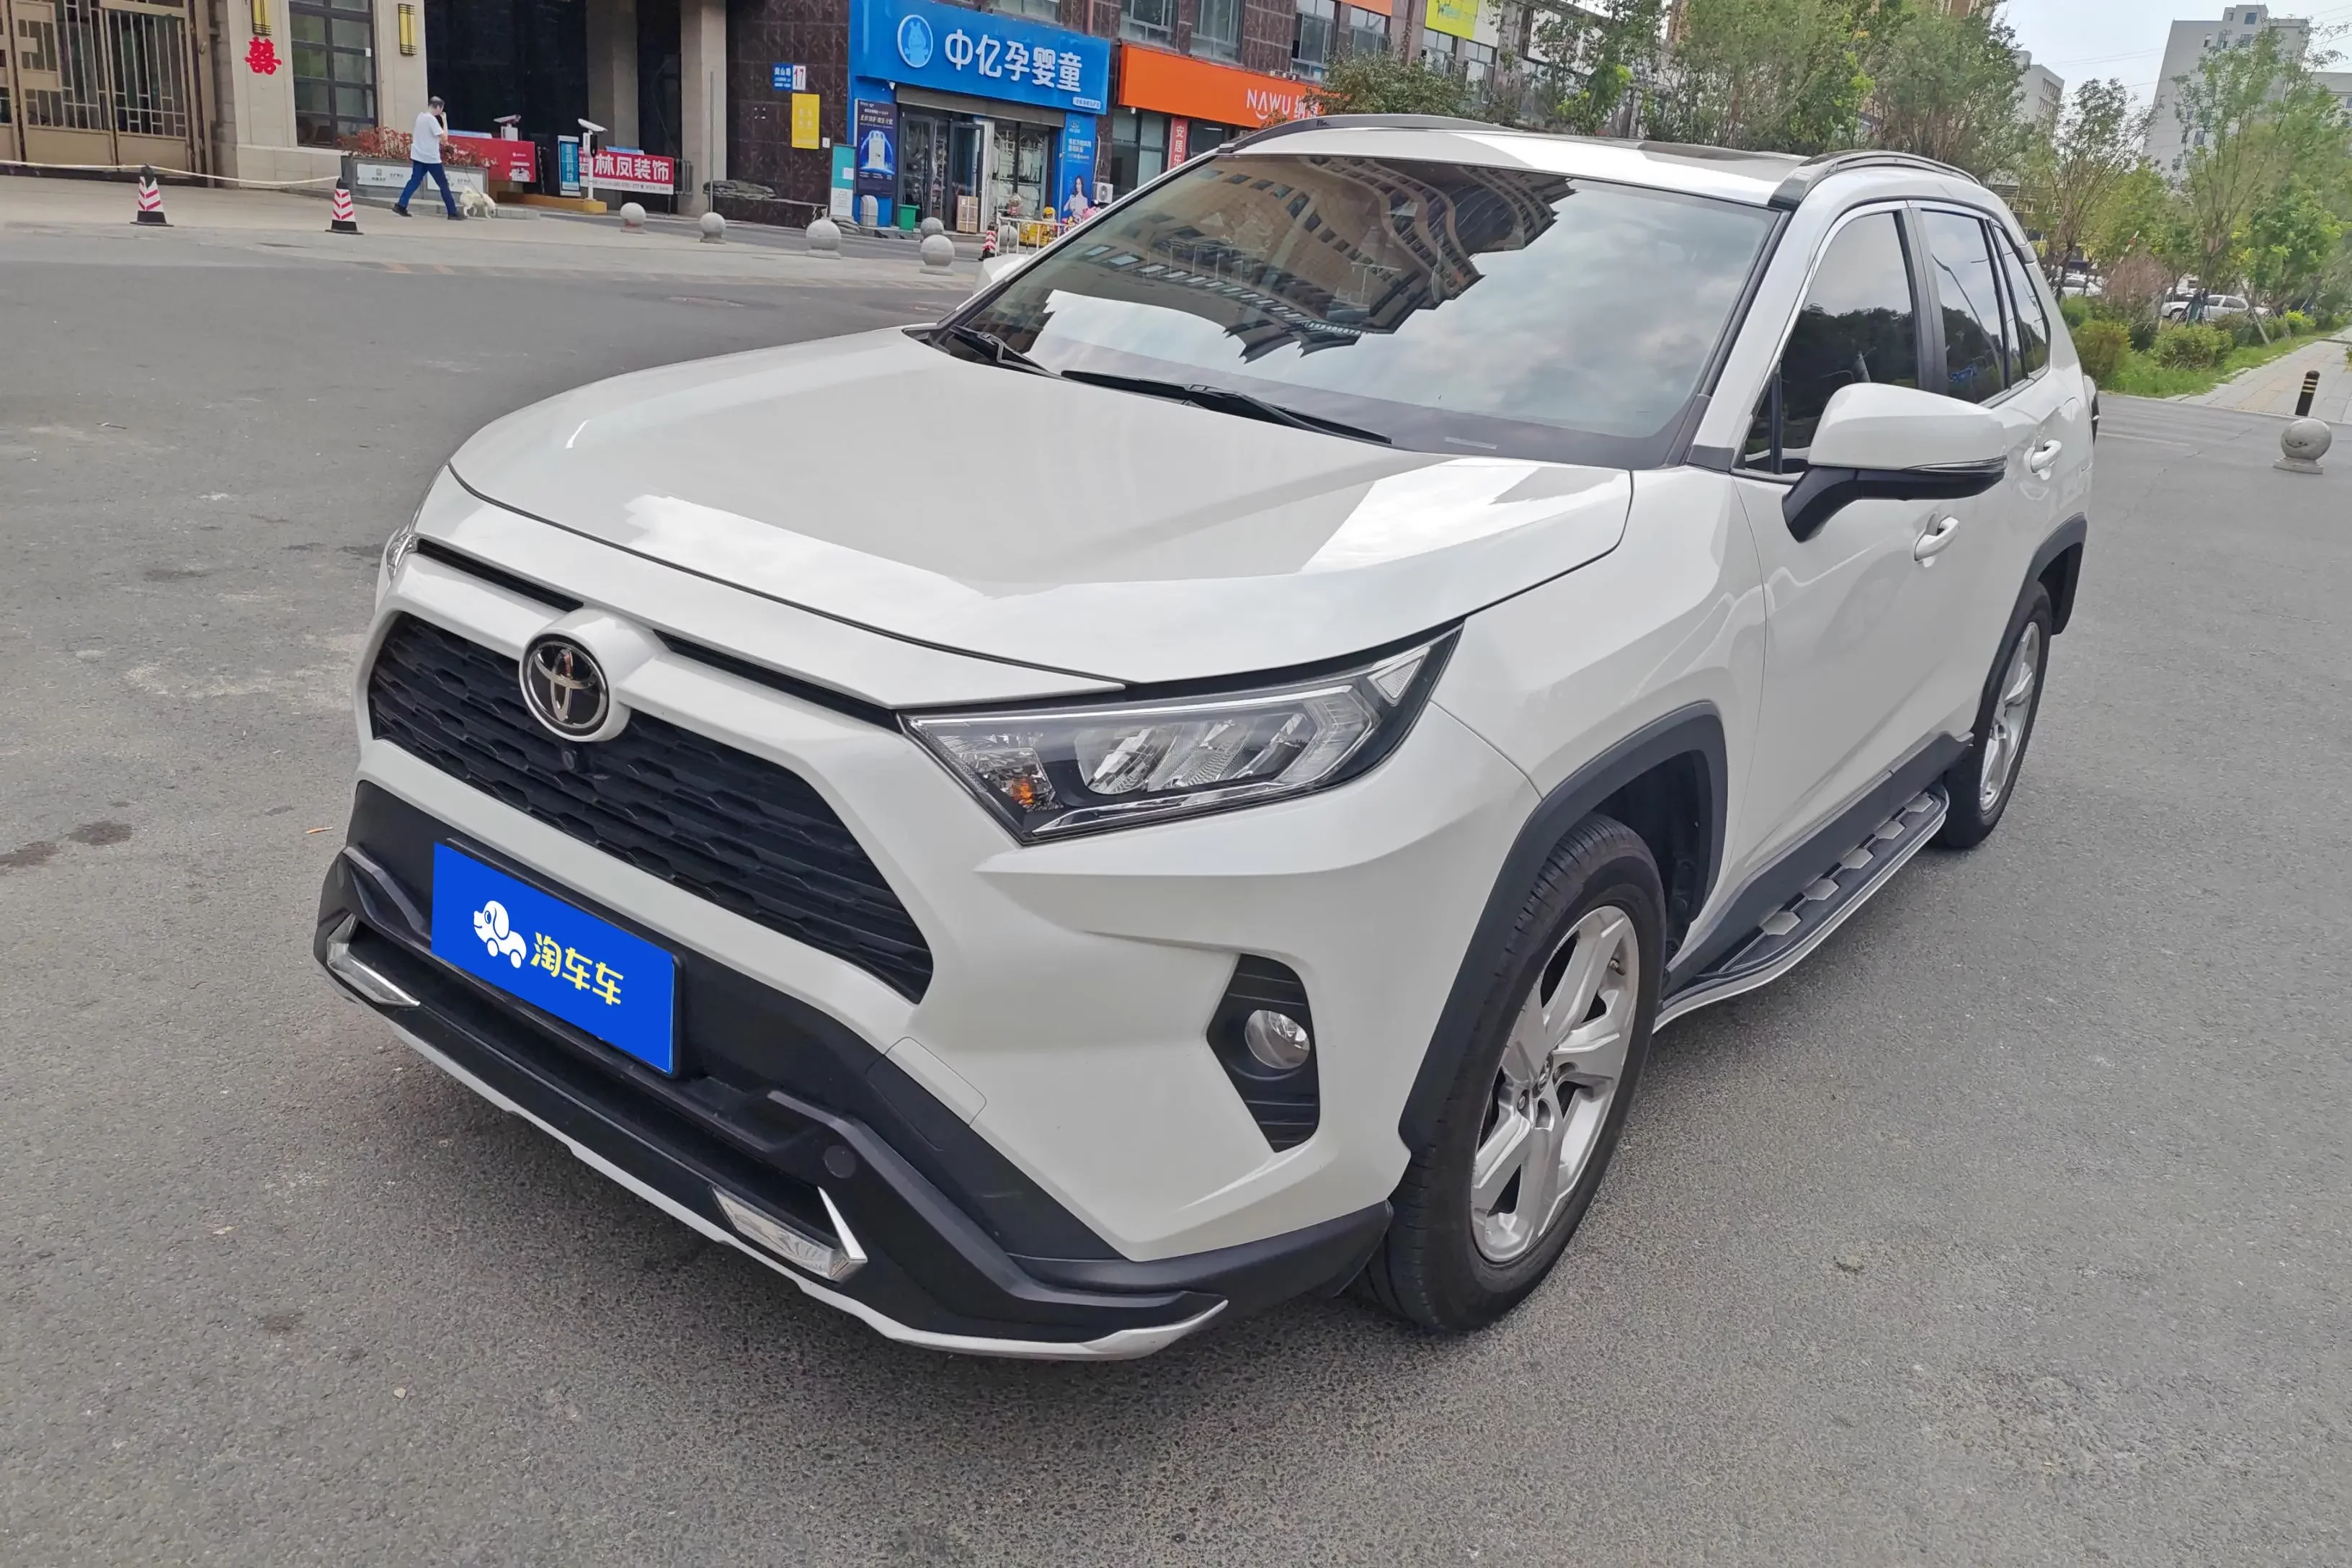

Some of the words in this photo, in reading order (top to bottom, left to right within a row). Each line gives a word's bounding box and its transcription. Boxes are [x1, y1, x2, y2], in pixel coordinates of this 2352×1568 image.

[945, 28, 1082, 93] 中亿孕婴童
[793, 68, 805, 87] 17
[1246, 87, 1291, 115] NAWU
[594, 153, 669, 182] 林凤装饰
